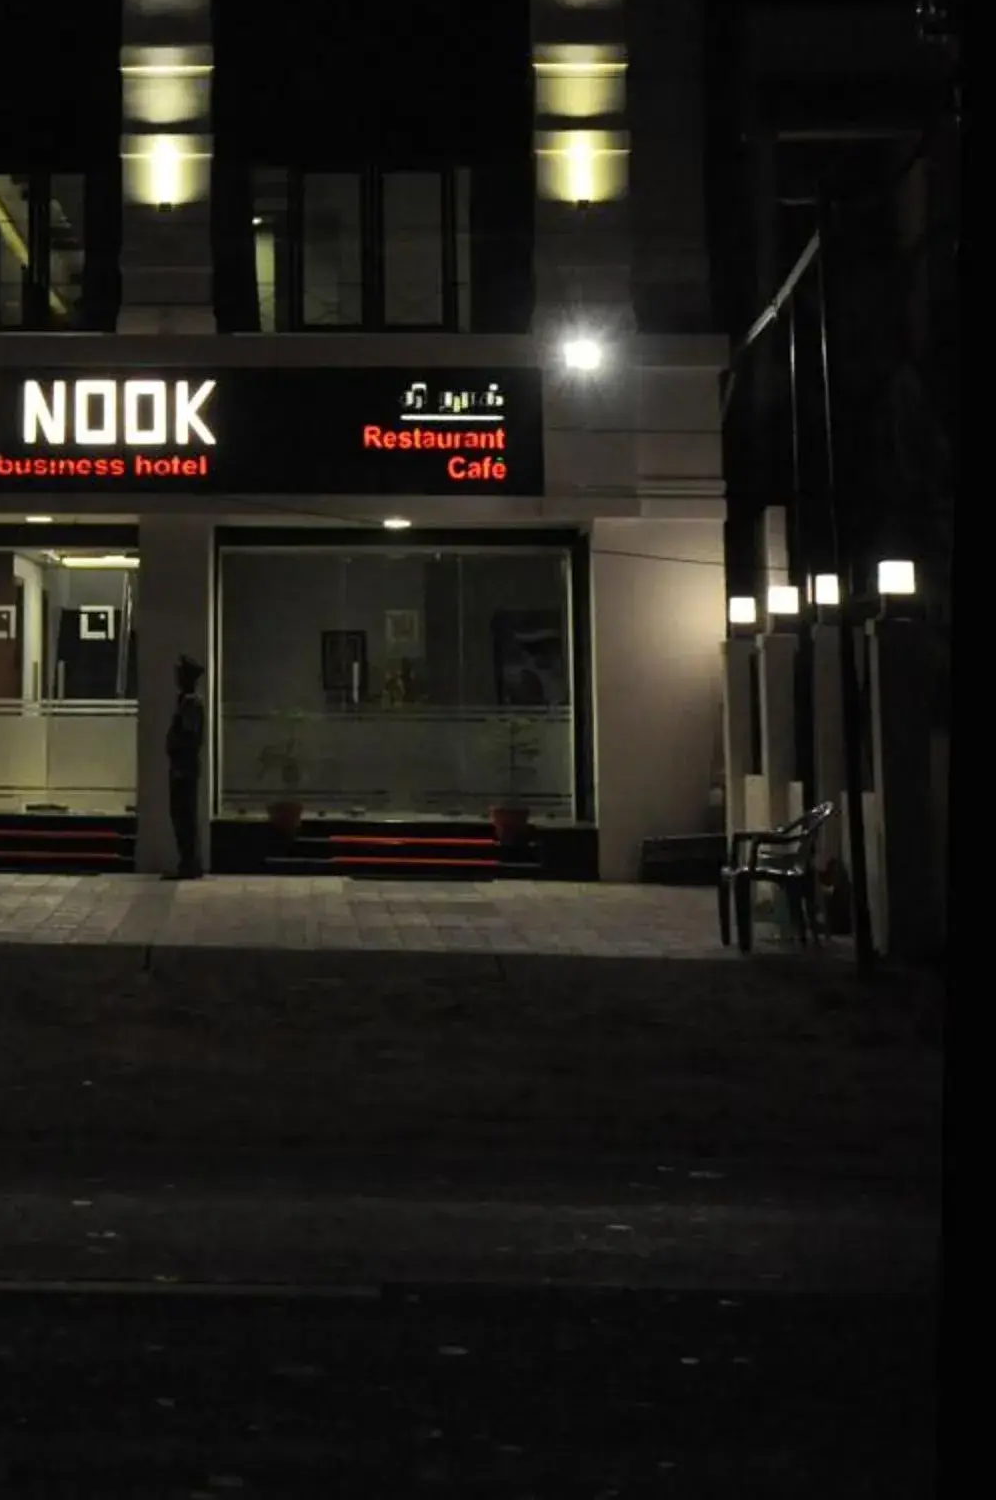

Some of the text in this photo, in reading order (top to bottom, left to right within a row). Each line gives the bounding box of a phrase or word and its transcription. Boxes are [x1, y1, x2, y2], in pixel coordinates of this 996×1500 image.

[23, 379, 217, 445] NOOK
[363, 425, 505, 449] Restaurant
[135, 455, 208, 476] hotel
[447, 456, 507, 479] Café
